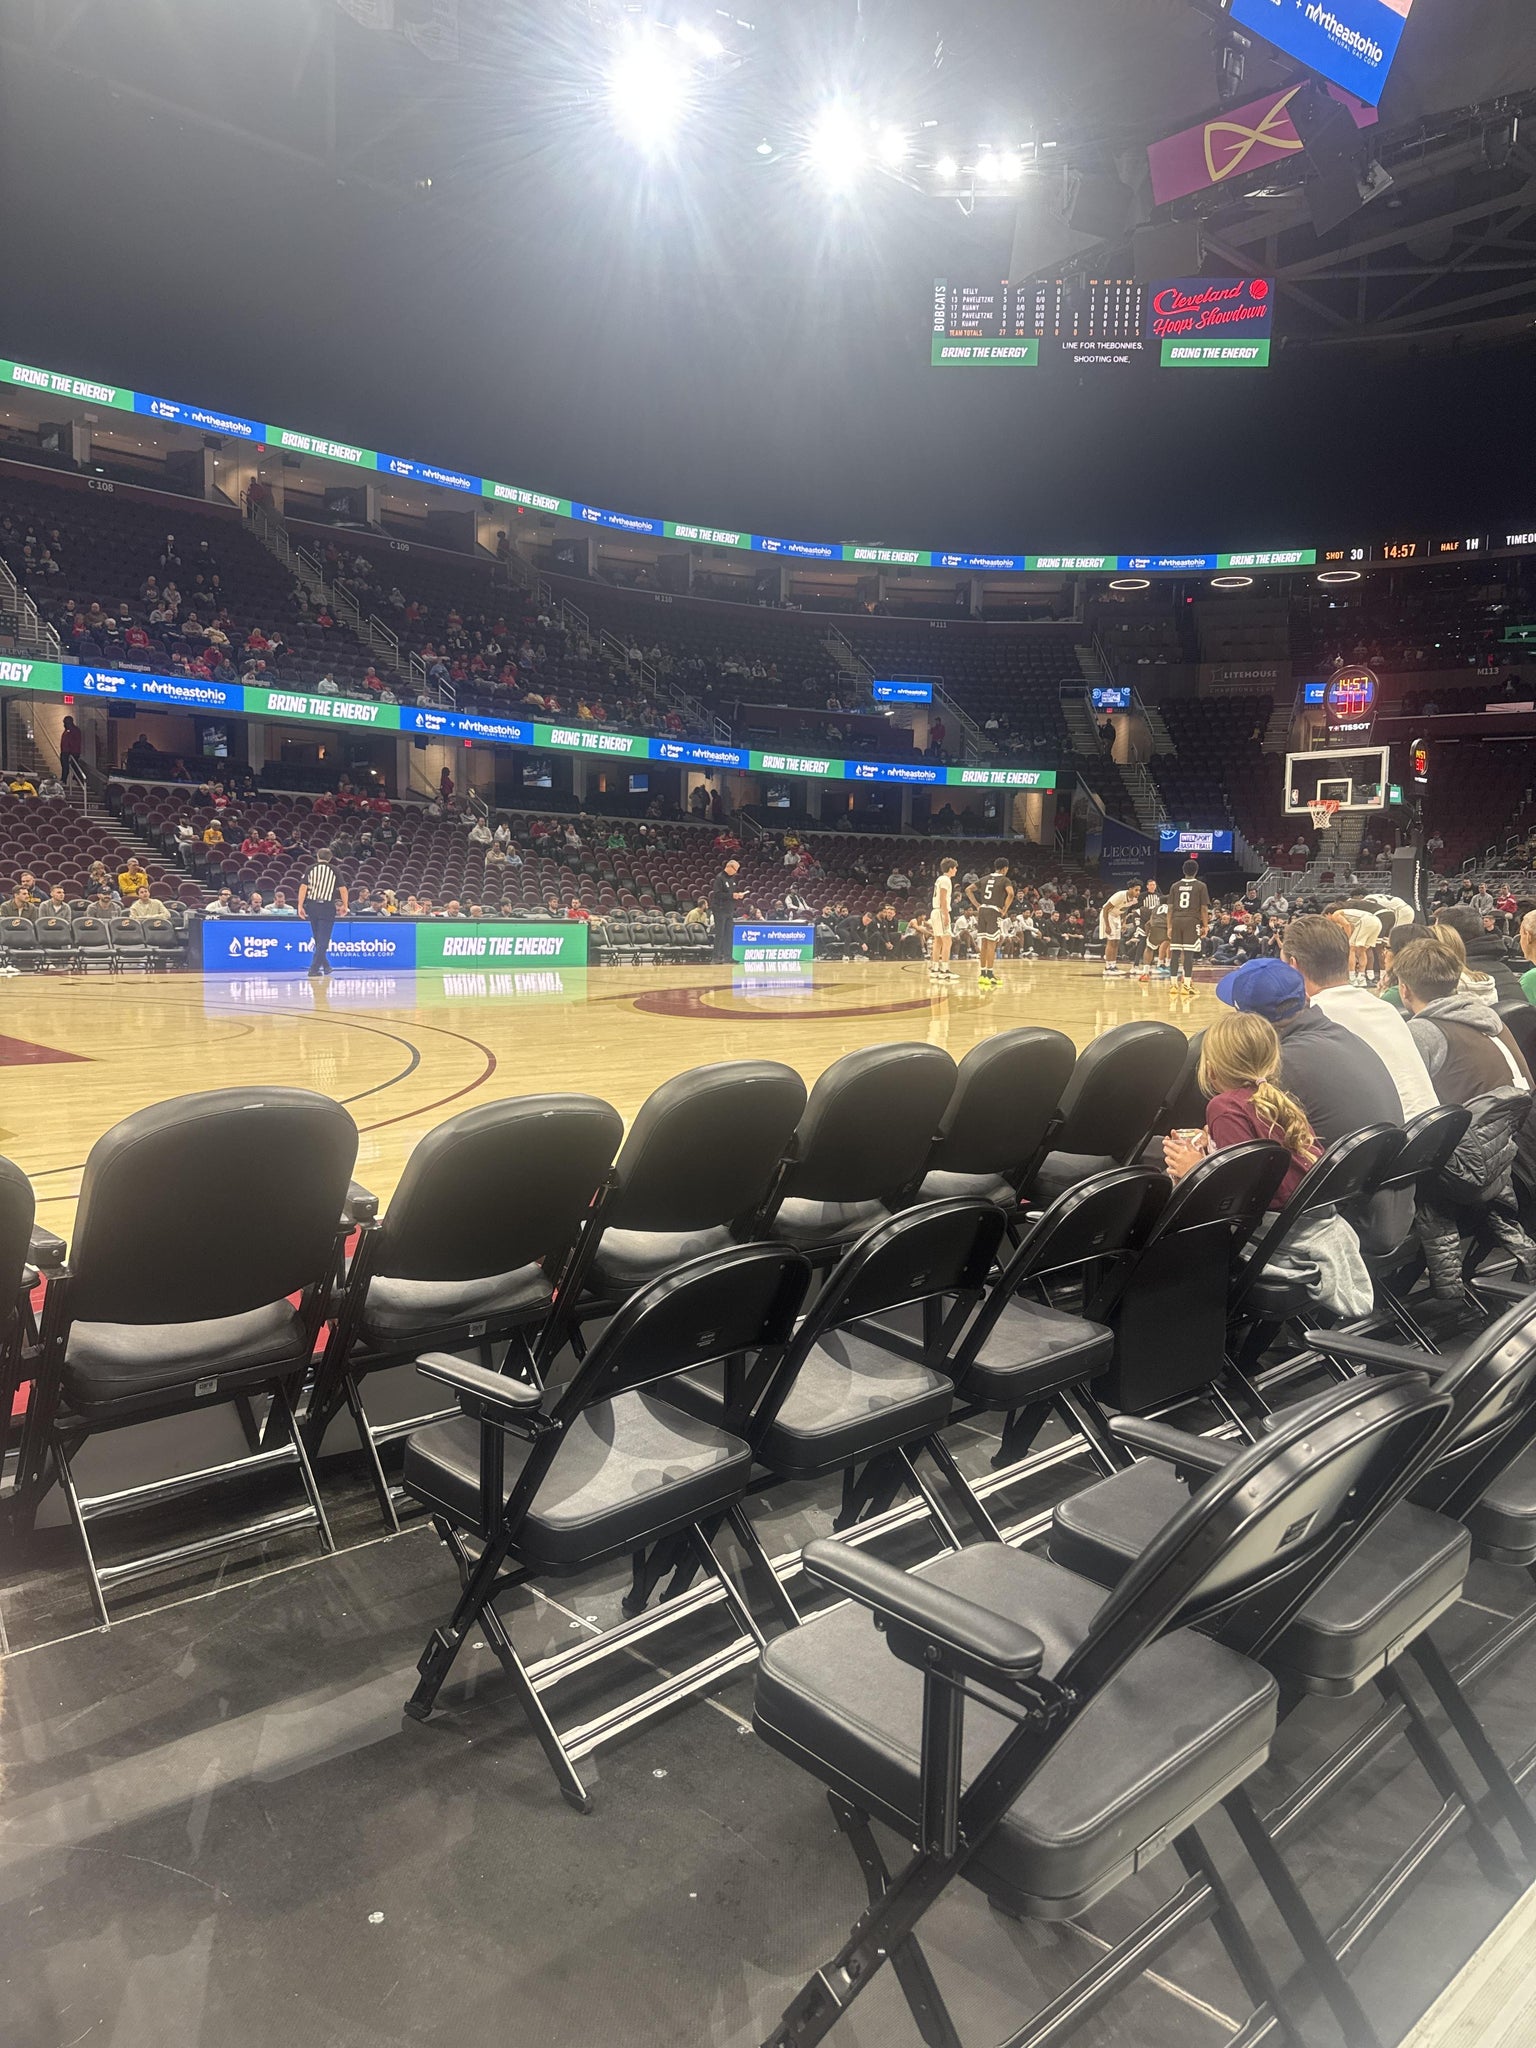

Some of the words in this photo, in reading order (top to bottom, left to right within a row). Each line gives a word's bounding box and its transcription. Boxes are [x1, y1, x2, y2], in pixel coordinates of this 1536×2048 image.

[1327, 33, 1350, 52] NATURAL
[1352, 47, 1363, 60] GAS
[1363, 56, 1378, 68] CORP
[1153, 280, 1245, 315] Cleveland
[934, 286, 946, 332] BOBCATS
[1153, 317, 1194, 337] Hoops
[1195, 304, 1268, 329] Showdown
[941, 347, 970, 358] BRING
[972, 347, 990, 358] THE
[991, 347, 1028, 358] ENERGY
[1073, 355, 1111, 363] SHOOTING
[1170, 347, 1201, 358] BRING
[1202, 347, 1221, 358] THE
[1221, 347, 1259, 358] ENERGY
[12, 366, 49, 387] BRING
[51, 375, 72, 393] THE
[72, 381, 116, 403] ENERGY
[281, 431, 310, 450] BRING
[311, 439, 329, 454] THE
[328, 443, 362, 463] ENERGY
[96, 481, 114, 493] 108
[494, 485, 518, 501] BRING
[518, 490, 532, 504] THE
[532, 494, 560, 511] ENERGY
[675, 525, 698, 539] BRING
[698, 529, 713, 541] THE
[712, 531, 740, 545] ENERGY
[1383, 543, 1416, 559] 14:57
[1440, 541, 1459, 551] HALF
[1465, 538, 1479, 550] 1H
[854, 548, 877, 560] BRING
[877, 550, 892, 561] THE
[891, 551, 919, 563] ENERGY
[1229, 554, 1255, 566] BRING
[1255, 553, 1271, 565] THE
[1270, 552, 1302, 564] ENERGY
[1325, 551, 1344, 560] SHOT
[1350, 548, 1363, 561] 30
[1037, 557, 1061, 568] BRING
[1061, 557, 1076, 568] THE
[1075, 557, 1105, 568] ENERGY
[0, 661, 33, 682] RGY
[96, 673, 125, 685] Hope
[1223, 670, 1277, 679] LITEHOUSE
[96, 683, 117, 693] Gas
[1339, 677, 1368, 692] 14:57
[267, 693, 307, 713] BRING
[309, 698, 331, 717] THE
[332, 702, 379, 722] ENERGY
[1336, 692, 1365, 715] 30
[425, 713, 446, 724] Hope
[425, 722, 440, 730] Gas
[1340, 722, 1371, 732] TISSOT
[550, 729, 580, 746] BRING
[581, 733, 598, 749] THE
[598, 735, 633, 752] ENERGY
[762, 755, 786, 770] BRING
[786, 757, 800, 771] THE
[800, 759, 830, 774] ENERGY
[962, 770, 989, 783] BRING
[990, 771, 1007, 783] THE
[1006, 771, 1040, 785] ENERGY
[1102, 845, 1151, 858] LECOM
[984, 884, 994, 900] 5
[1179, 891, 1190, 908] 8
[244, 936, 278, 949] Hope
[442, 937, 486, 956] BRING
[488, 937, 514, 956] THE
[514, 937, 564, 956] ENERGY
[244, 947, 269, 958] Gas
[744, 949, 765, 960] BRING
[765, 949, 778, 960] THE
[777, 949, 802, 960] ENERGY
